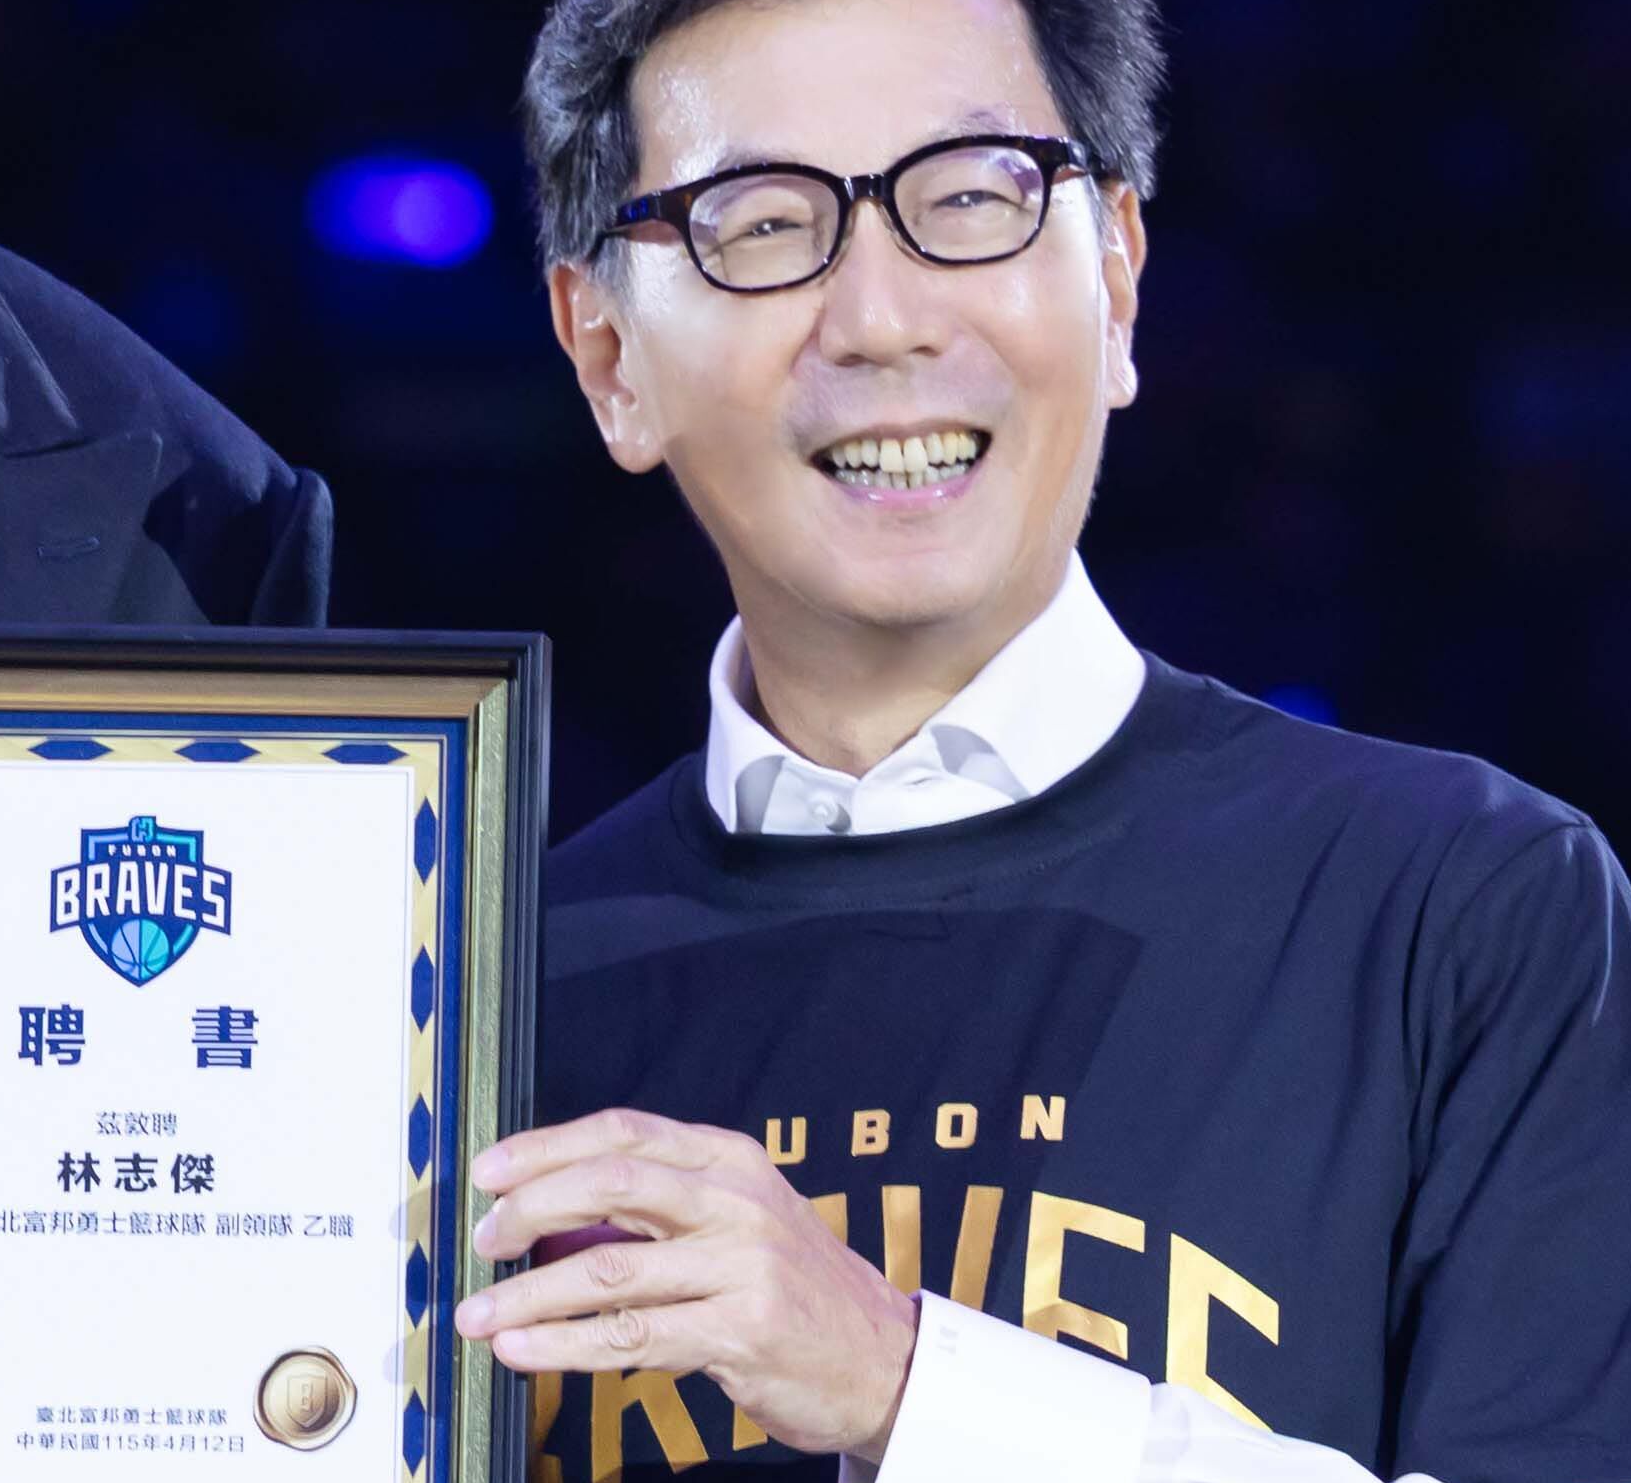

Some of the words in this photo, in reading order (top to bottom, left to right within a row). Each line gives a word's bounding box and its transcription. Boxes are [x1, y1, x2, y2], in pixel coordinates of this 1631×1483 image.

[55, 860, 226, 929] BRAVES
[17, 1003, 260, 1070] 聘書
[765, 1094, 1067, 1165] UBON
[56, 1151, 216, 1196] 林志傑
